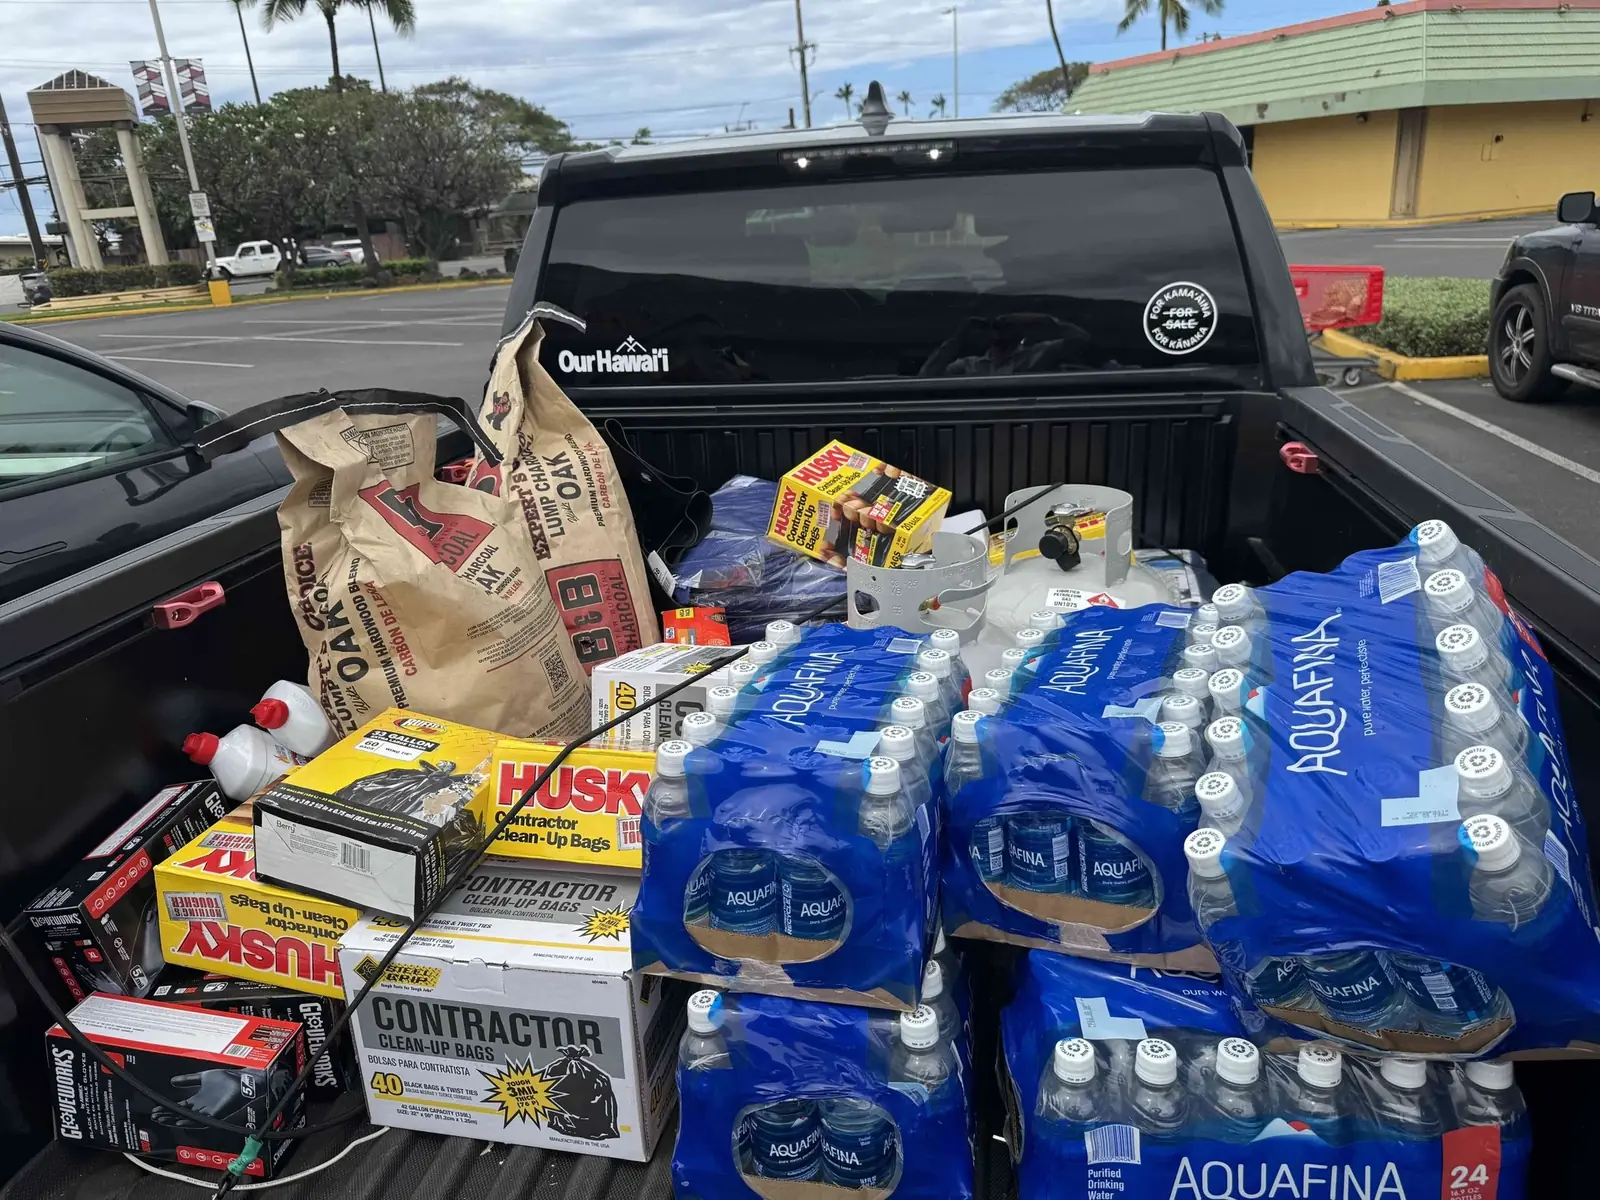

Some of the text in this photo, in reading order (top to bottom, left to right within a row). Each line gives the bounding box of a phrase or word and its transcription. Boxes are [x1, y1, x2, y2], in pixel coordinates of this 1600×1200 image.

[1151, 327, 1169, 346] FOR
[542, 451, 581, 500] OAK
[791, 445, 852, 486] HUSKY
[592, 457, 610, 508] CARBÓN DE
[817, 474, 843, 491] Contractor
[510, 472, 552, 561] EXPERT'S
[540, 496, 565, 538] LUMP
[588, 488, 605, 527] PREMIUM
[774, 485, 797, 537] HUSKY
[786, 491, 808, 542] Contractor
[796, 504, 817, 546] Clean-Up
[805, 526, 820, 551] Bags
[461, 544, 500, 580] HARCOAL
[475, 564, 506, 590] AK
[380, 609, 397, 627] DE
[326, 599, 370, 683] OAK
[348, 557, 410, 709] PREMIUM HARDWOOD BLEND
[388, 627, 418, 677] CARBÓN
[1038, 625, 1124, 696] AQUAFINA
[615, 682, 637, 711] 40
[762, 648, 855, 726] AQUAFINA
[1287, 613, 1348, 776] AQUAFINA
[536, 725, 549, 734] BEST
[1363, 712, 1377, 737] pure
[371, 729, 435, 749] 33 GALLON
[498, 762, 651, 816] HUSKY
[276, 819, 296, 834] Berry
[571, 834, 611, 852] Bags
[172, 897, 220, 909] TOUGHER
[174, 908, 222, 918] NOTHING'S
[230, 894, 270, 913] Bags
[462, 894, 581, 913] CLEAN-UP BAGS
[469, 906, 554, 920] BOLSAS PARA CONTRATISTA
[30, 912, 82, 928] GLOVEWORKS
[457, 920, 478, 928] TWIST
[88, 950, 97, 960] XL
[177, 920, 342, 988] HUSKY
[131, 965, 146, 989] 5 mil
[1182, 988, 1210, 998] pure
[372, 996, 603, 1055] CONTRACTOR
[378, 1033, 495, 1062] CLEAN-UP BAGS
[368, 1054, 471, 1077] BOLSAS PARA CONTRATISTA
[52, 1047, 83, 1140] GLOVEWORKS
[241, 1082, 252, 1096] 5
[371, 1071, 404, 1096] 40
[404, 1080, 422, 1089] BLACK
[423, 1083, 440, 1091] BAGS
[446, 1086, 465, 1094] TWIST
[506, 1079, 531, 1087] TOUGH
[408, 1104, 429, 1112] GALLON
[429, 1107, 454, 1116] CAPACITY
[549, 1136, 585, 1146] MANUFACTURED
[1088, 1169, 1122, 1178] Purified
[1088, 1180, 1125, 1190] Drinking
[1168, 1156, 1407, 1200] AQUAFINA
[1450, 1163, 1489, 1188] 24
[1088, 1191, 1114, 1200] Water
